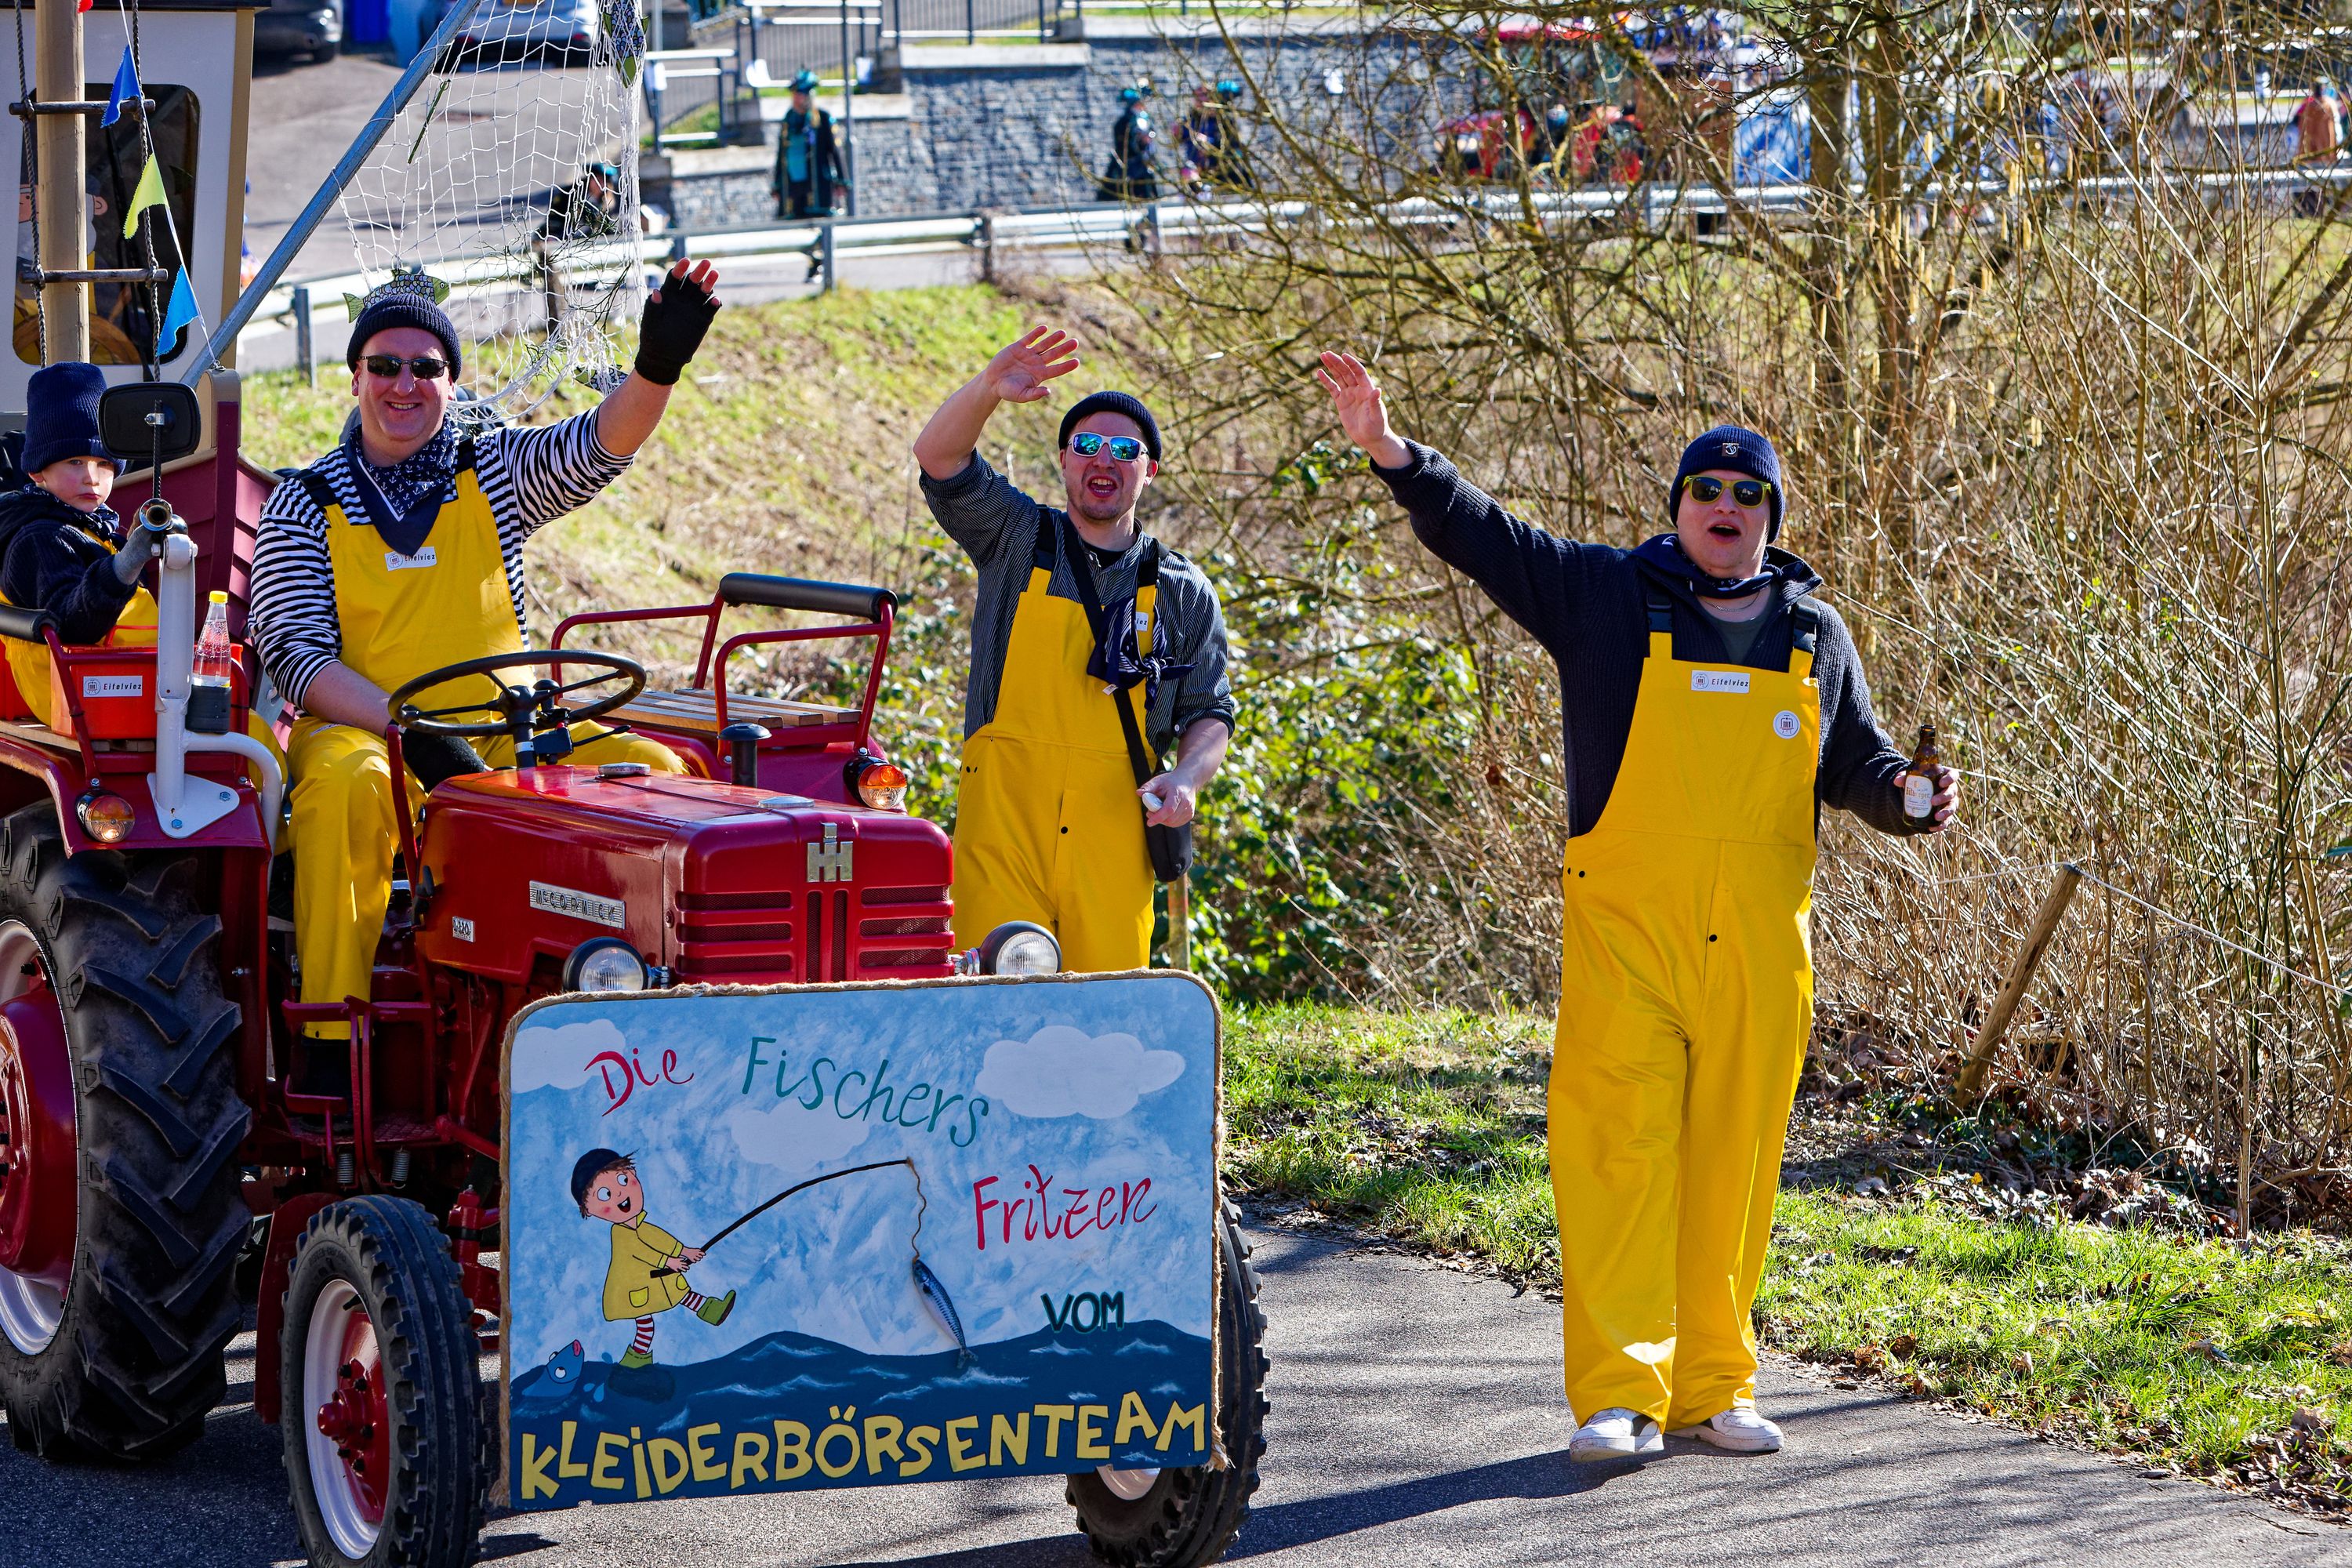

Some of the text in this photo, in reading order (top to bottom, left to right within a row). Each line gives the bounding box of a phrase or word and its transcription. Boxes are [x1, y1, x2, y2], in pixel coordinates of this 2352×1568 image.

[103, 682, 142, 691] Eifelviez
[1711, 678, 1749, 687] Eifelviez
[583, 1036, 989, 1148] Die Fischers
[973, 1163, 1158, 1250] Fritzen
[1040, 1290, 1125, 1334] VOM
